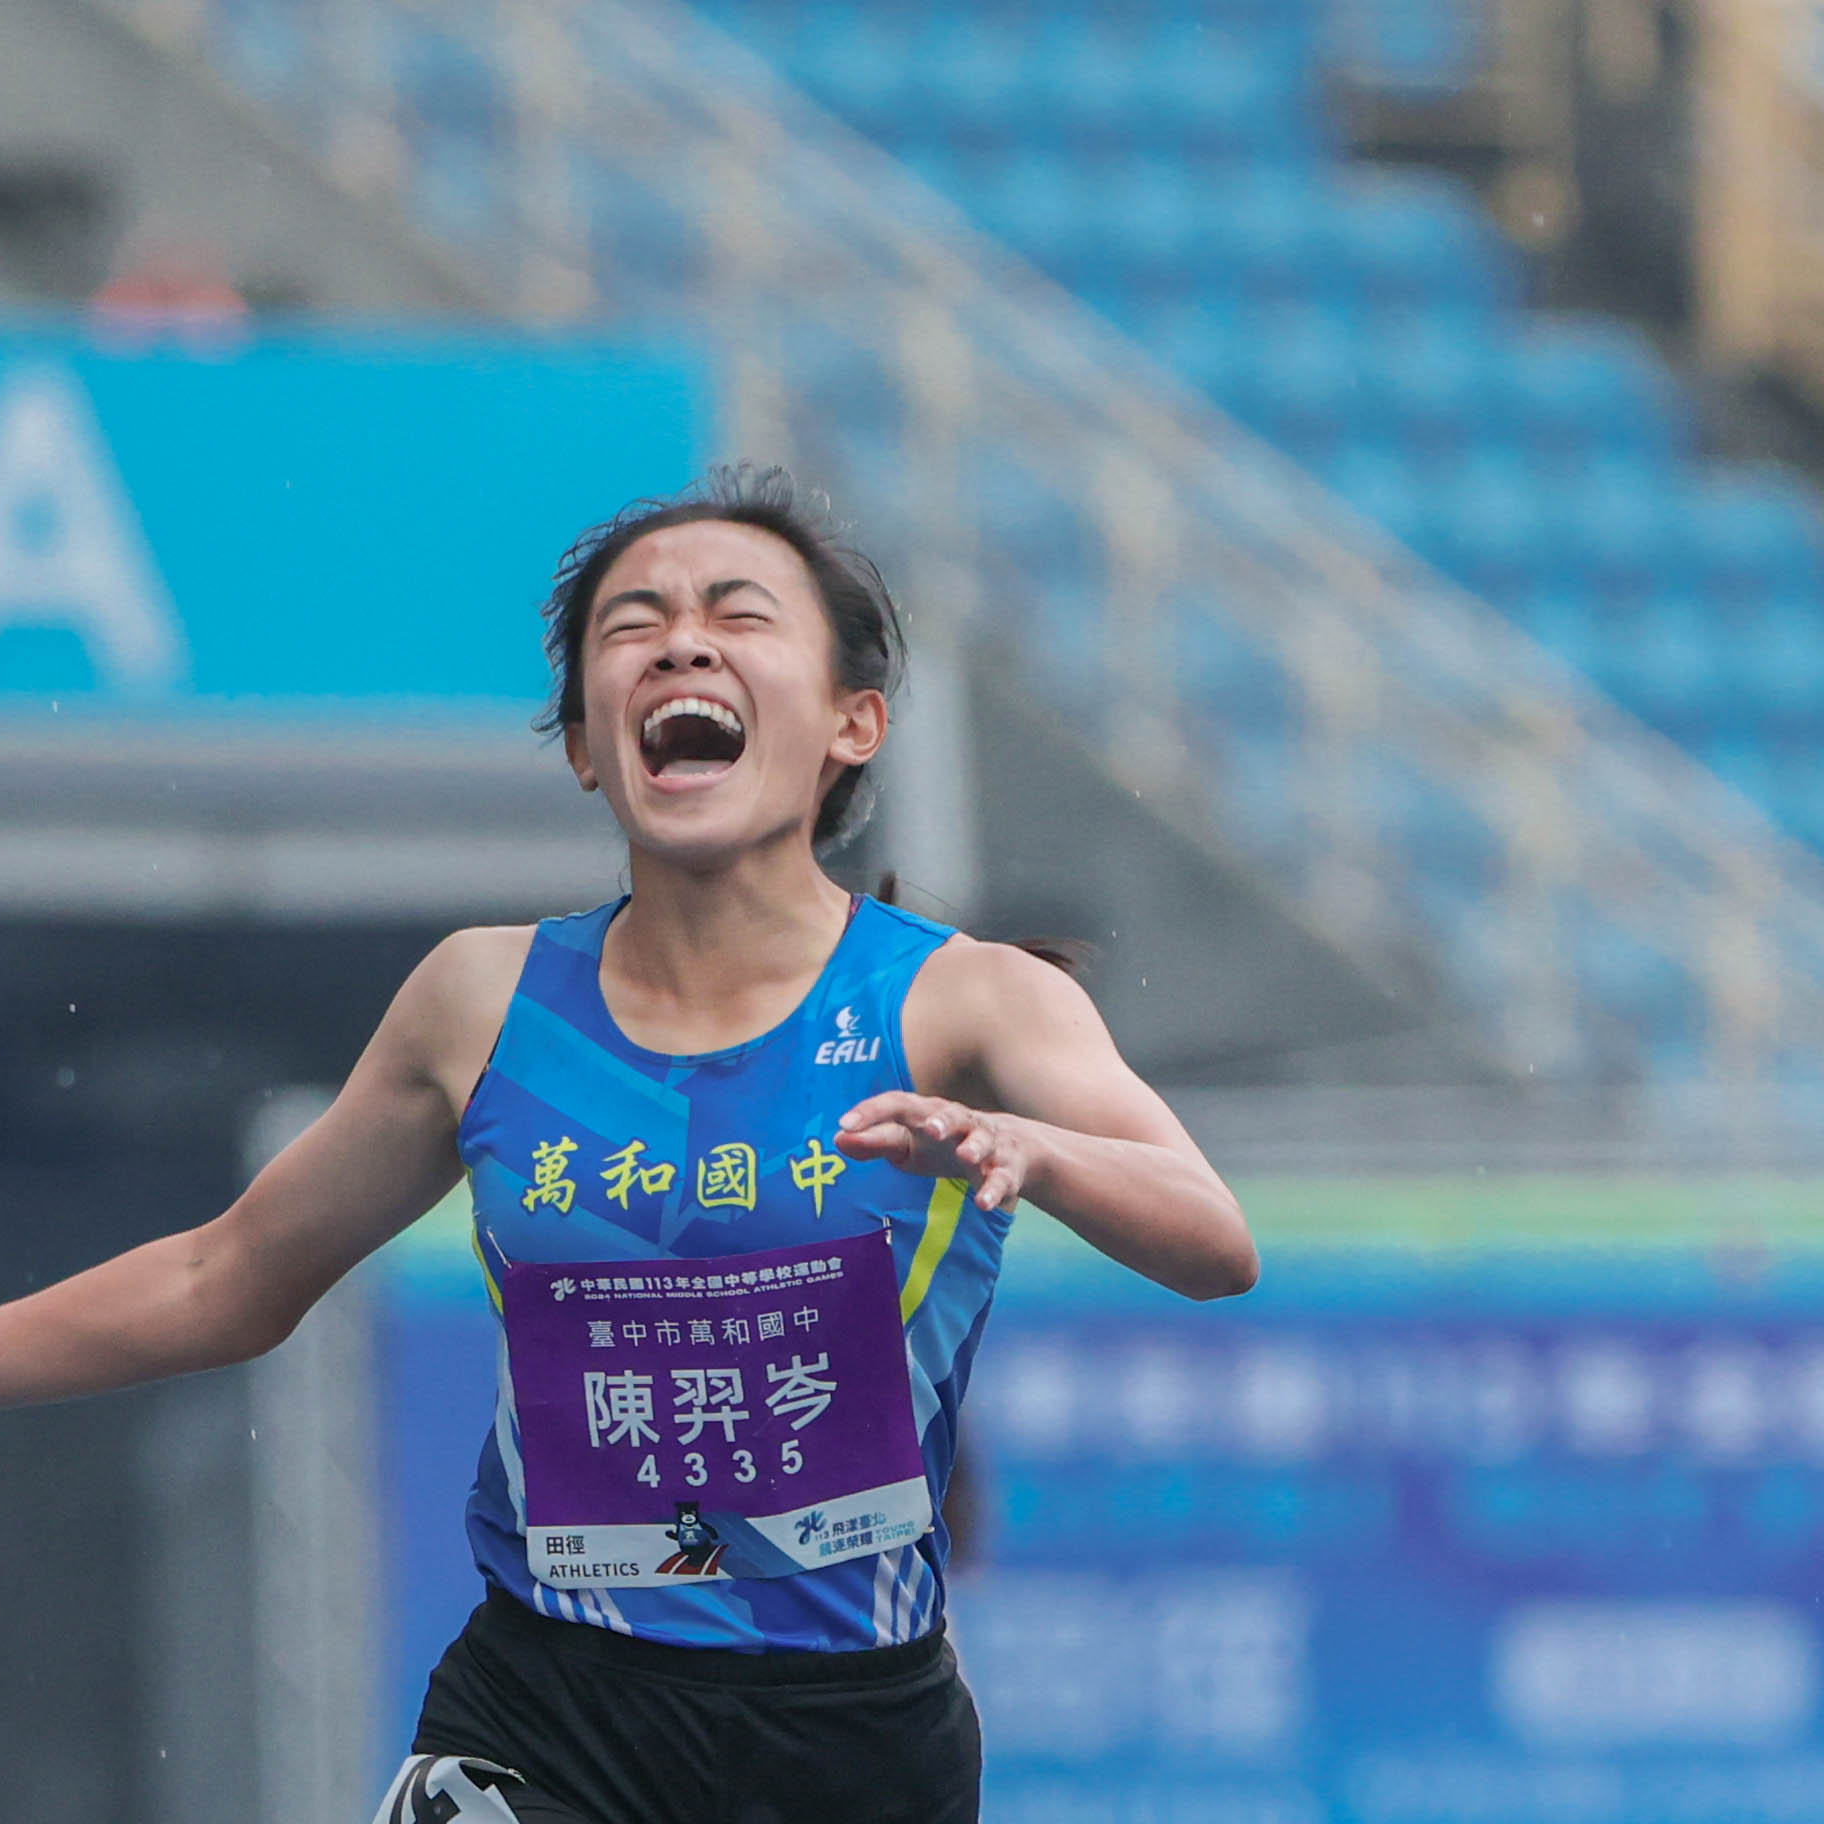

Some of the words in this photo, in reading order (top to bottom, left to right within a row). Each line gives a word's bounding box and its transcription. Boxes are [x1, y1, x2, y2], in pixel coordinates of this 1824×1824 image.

[814, 1036, 881, 1066] EALI
[522, 1136, 847, 1219] 萬和國中
[706, 1288, 751, 1298] SCHOOL
[753, 1278, 803, 1293] ATHLETIC
[806, 1271, 845, 1284] GAMES
[586, 1305, 819, 1348] 臺中市萬和國中
[583, 1352, 837, 1447] 陳羿岑
[636, 1439, 804, 1488] 4335
[546, 1535, 585, 1555] 田徑
[549, 1562, 640, 1578] ATHLETICS
